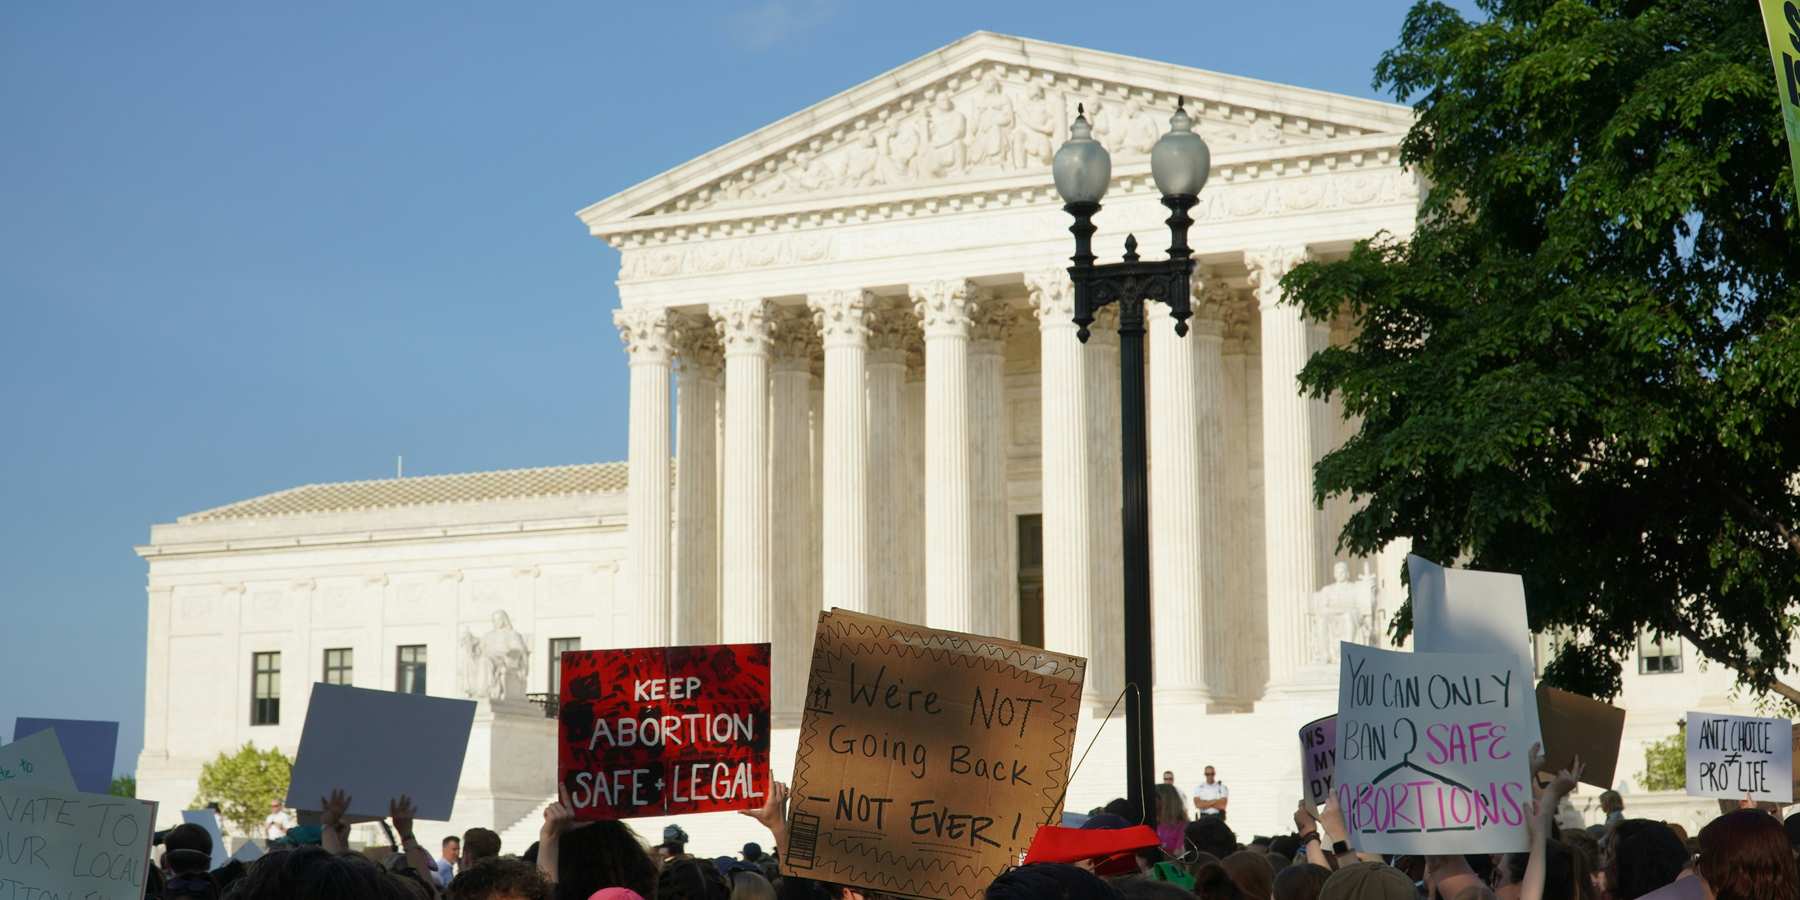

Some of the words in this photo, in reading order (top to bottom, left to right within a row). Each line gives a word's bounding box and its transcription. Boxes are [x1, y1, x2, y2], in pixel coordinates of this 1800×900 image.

[634, 677, 701, 701] KEEP
[850, 663, 943, 714] We're
[970, 687, 1043, 738] NOT
[1348, 653, 1374, 708] YOU
[1382, 673, 1419, 708] CAN
[1428, 670, 1511, 709] ONLY
[588, 713, 753, 750] ABORTION
[1343, 722, 1386, 760] BAN
[1425, 722, 1511, 765] SAFE
[1699, 718, 1728, 751] ANTI
[1730, 720, 1773, 754] CHOICE
[829, 724, 928, 779] Going
[950, 745, 1032, 786] Back
[1700, 761, 1728, 791] PRO
[1738, 760, 1771, 792] LIFE
[572, 768, 650, 809] SAFE
[672, 762, 764, 803] LEGAL
[1338, 781, 1523, 834] ABORTIONS
[88, 803, 139, 847] TO
[73, 843, 141, 888] LOCAL
